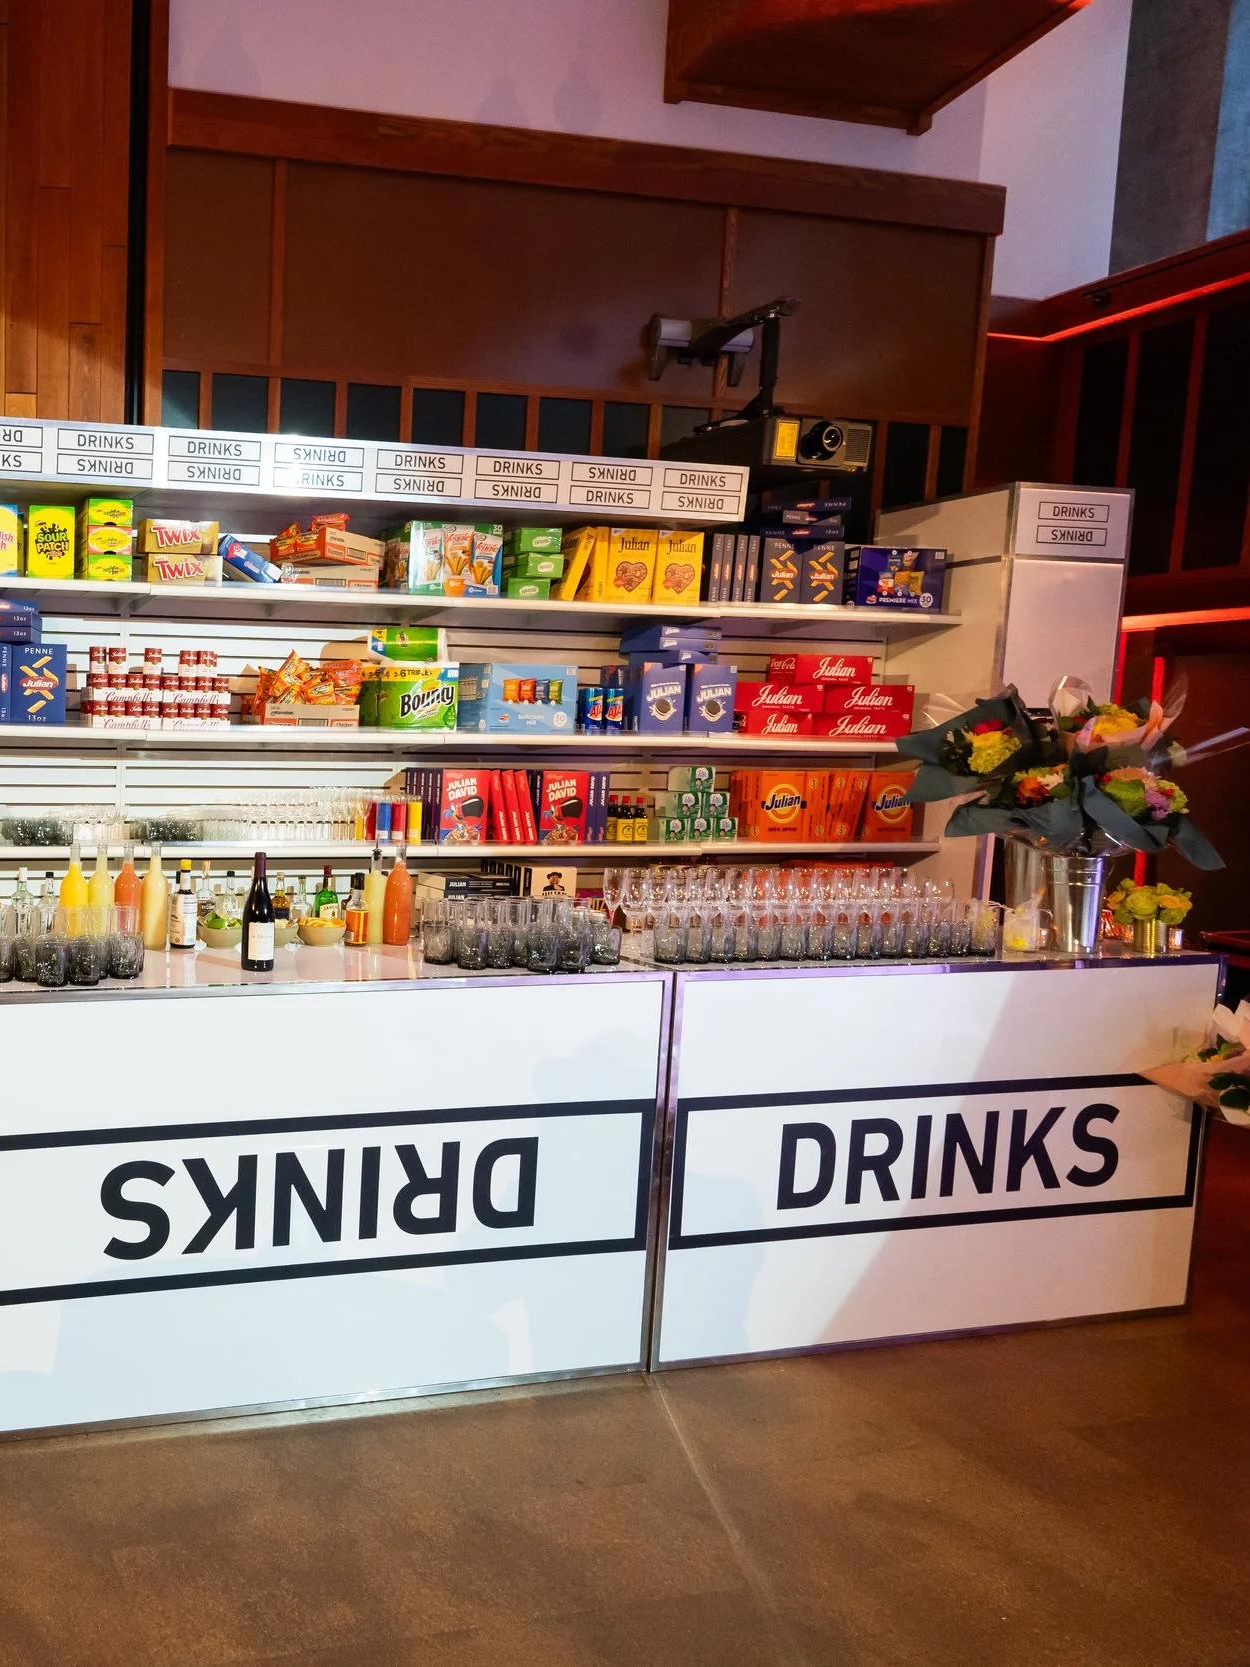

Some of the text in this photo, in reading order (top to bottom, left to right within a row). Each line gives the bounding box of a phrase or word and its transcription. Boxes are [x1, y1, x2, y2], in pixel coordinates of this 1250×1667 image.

[78, 434, 134, 450] DRINKS
[188, 440, 242, 456] DRINKS
[294, 448, 346, 462] DRINKS
[395, 454, 446, 470] DRINKS
[77, 459, 134, 475] DRINKS
[187, 466, 241, 481] DRINKS
[494, 461, 542, 476] DRINKS
[588, 467, 636, 481] DRINKS
[293, 472, 344, 486] RINKS
[394, 478, 444, 493] DRINKS
[680, 473, 726, 488] DRINKS
[492, 484, 541, 498] DRINKS
[586, 490, 634, 504] DRINKS
[678, 496, 724, 510] DRINKS
[1053, 506, 1095, 519] DRINKS
[492, 524, 502, 532] 30
[1051, 529, 1092, 542] DRINKS
[37, 532, 68, 542] SOUR
[36, 540, 69, 550] PATCH
[618, 537, 650, 553] Julian
[666, 539, 696, 554] Julian
[774, 542, 795, 550] PENNE
[771, 570, 794, 580] Julian
[810, 570, 836, 580] Julian
[879, 596, 906, 604] PREMIERE
[921, 595, 932, 604] 30
[812, 656, 856, 679] Julian
[22, 680, 53, 688] Julian
[104, 692, 152, 702] Campbell's
[172, 693, 220, 704] Campbell's
[400, 685, 454, 718] Bounty
[646, 686, 682, 702] JULIAN
[696, 687, 732, 702] JULIAN
[752, 684, 802, 707] Julian
[844, 686, 894, 708] Julian
[28, 714, 47, 722] 13oz
[761, 713, 798, 735] Julian
[828, 714, 887, 737] Julian
[446, 777, 478, 792] JULIAN
[546, 779, 576, 794] JULIAN
[448, 786, 478, 801] DAVID
[548, 788, 576, 802] DAVID
[765, 794, 800, 812] Julian
[776, 1102, 1120, 1212] DRINKS
[100, 1136, 539, 1261] DRINKS
